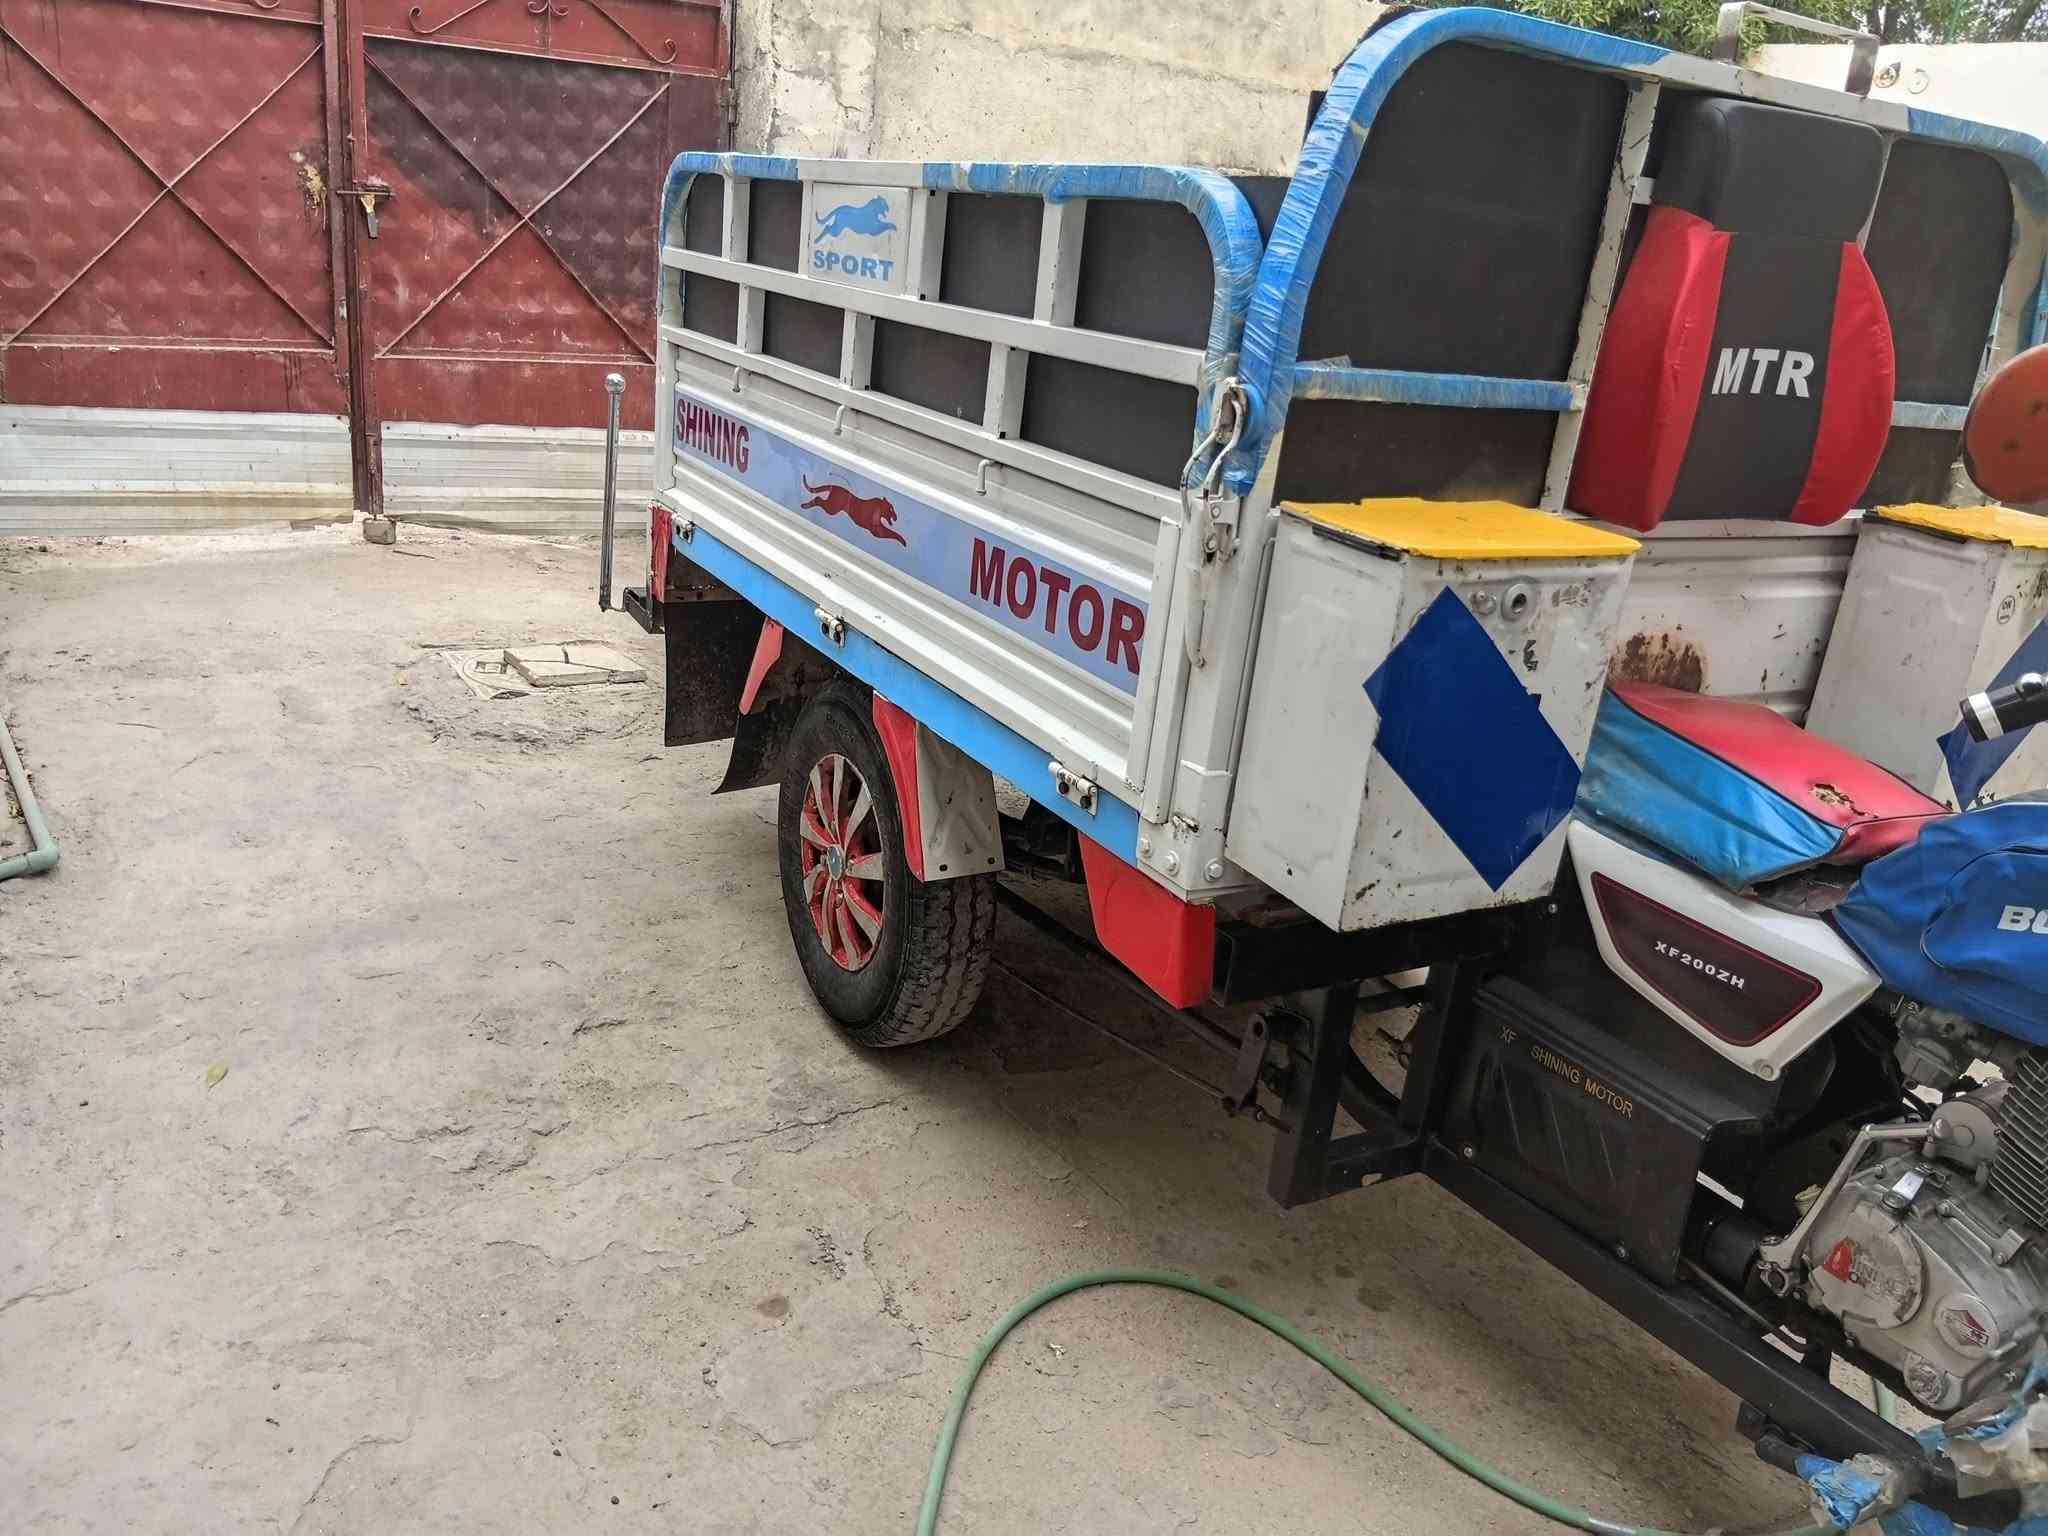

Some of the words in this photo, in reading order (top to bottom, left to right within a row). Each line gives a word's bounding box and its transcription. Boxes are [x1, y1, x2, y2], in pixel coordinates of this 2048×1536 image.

[814, 249, 894, 281] SPORT
[1711, 347, 1815, 398] MTR
[676, 398, 749, 473] SHINING
[969, 537, 1146, 676] MOTOR
[1654, 940, 1745, 990] XF200ZH
[1500, 1024, 1518, 1045] XF
[1530, 1044, 1581, 1084] SHINING
[1583, 1078, 1634, 1120] MOTOR
